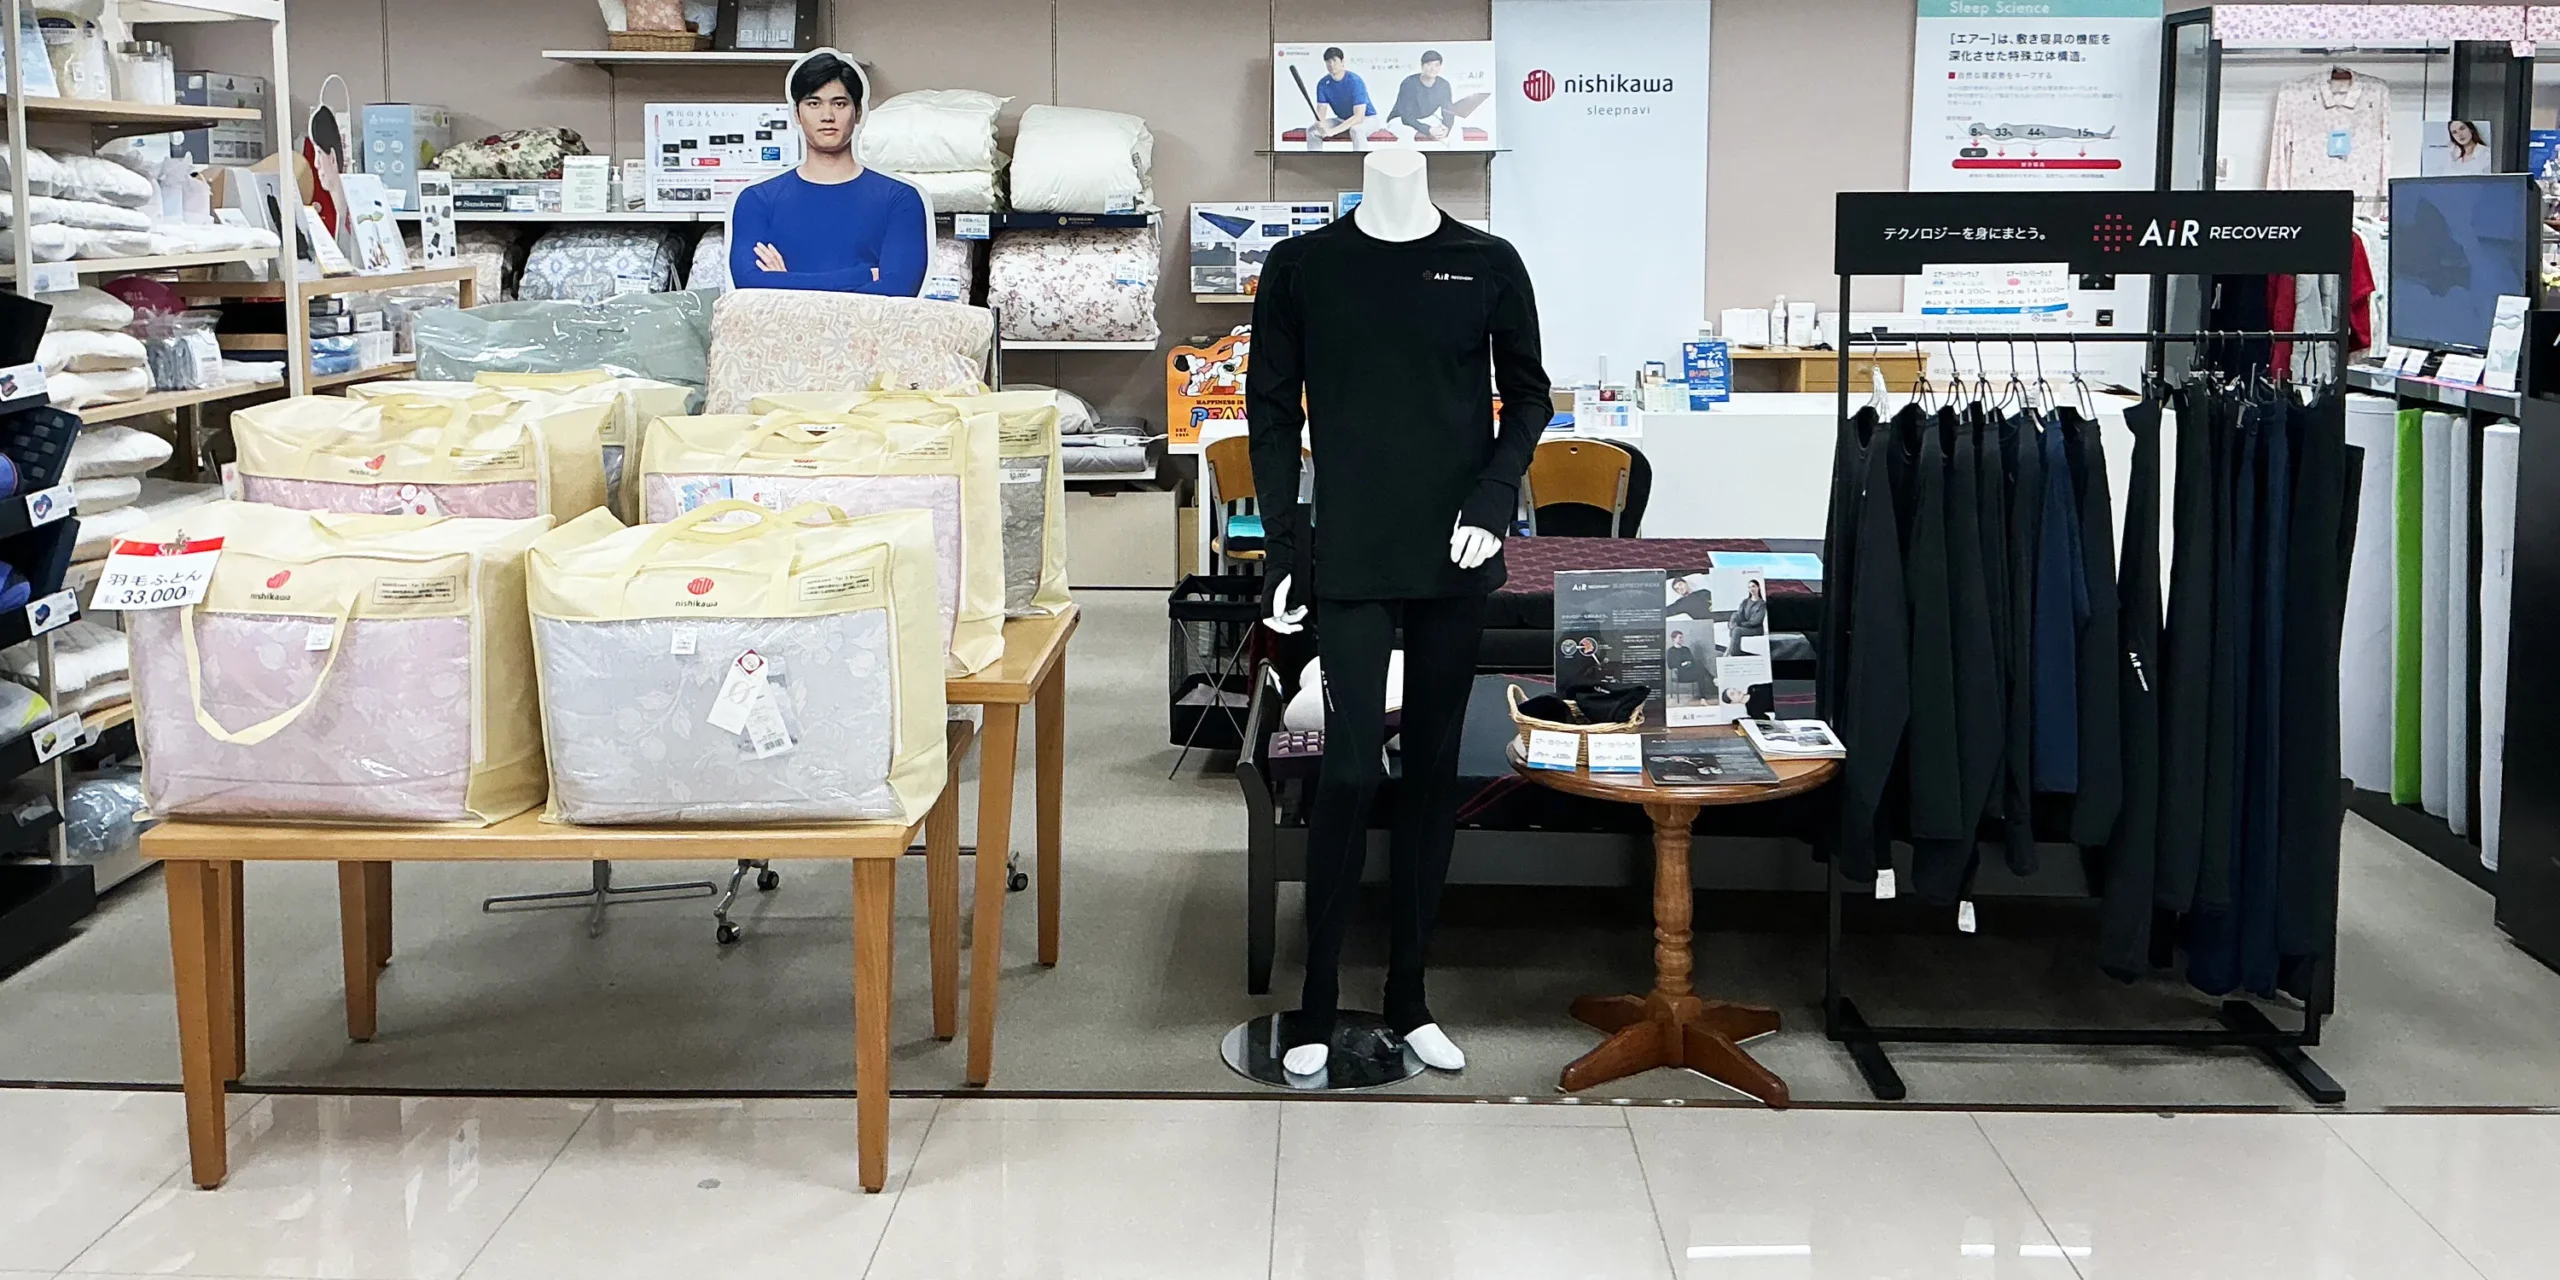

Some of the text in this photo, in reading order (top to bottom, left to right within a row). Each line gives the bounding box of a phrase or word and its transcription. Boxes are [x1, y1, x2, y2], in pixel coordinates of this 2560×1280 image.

[1950, 0, 2051, 16] Sleep Science
[1949, 50, 2087, 62] 深化させた特殊立体構造。
[1564, 74, 1674, 93] nishikawa
[1587, 105, 1651, 117] sleepnavi
[463, 200, 502, 208] Sanderson
[1883, 226, 2046, 241] テクノロジーを身にまとう。
[2209, 226, 2302, 240] RECOVERY
[107, 570, 203, 587] 羽毛ふとん
[675, 600, 718, 608] nishikawa
